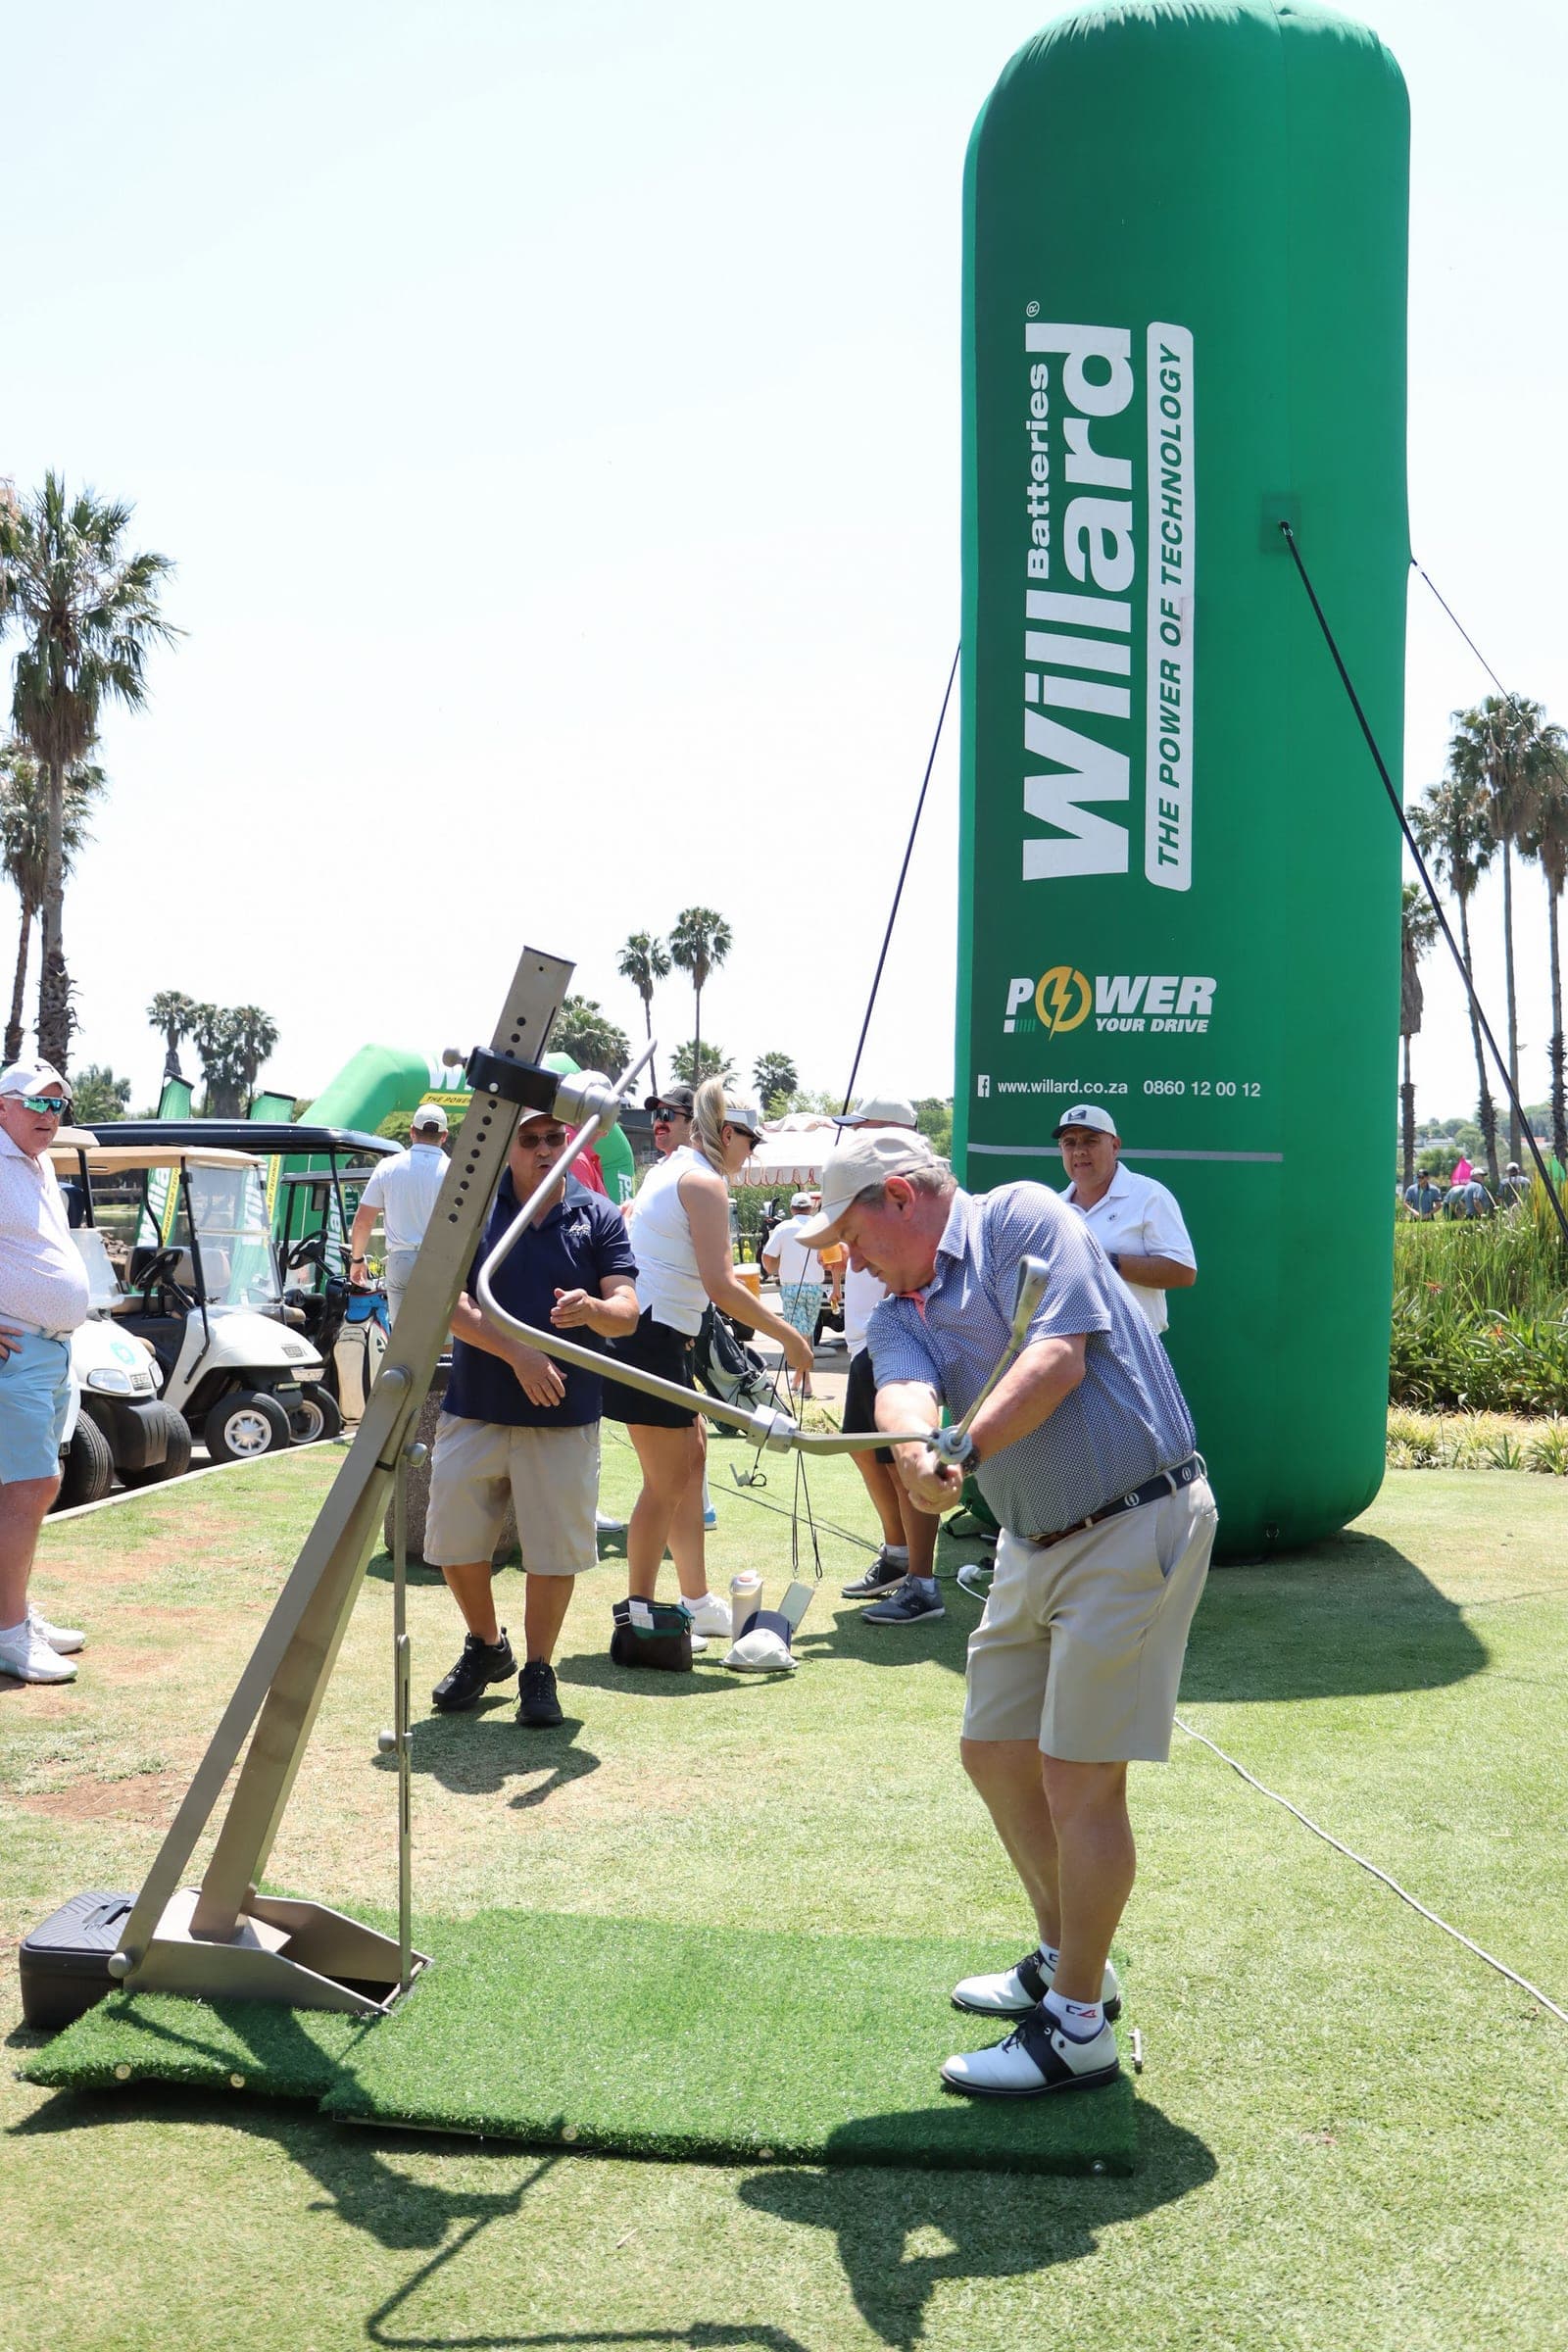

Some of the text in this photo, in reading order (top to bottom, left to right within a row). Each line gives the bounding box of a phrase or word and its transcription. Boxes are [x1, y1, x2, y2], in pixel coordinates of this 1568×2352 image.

[1026, 363, 1049, 580] Batteries
[1023, 322, 1135, 881] Willard
[1158, 344, 1183, 866] THE POWER OF TECHNOLOGY
[998, 1079, 1128, 1094] www.willard.co.za
[1143, 1080, 1185, 1096] 0860
[1191, 1081, 1210, 1096] 12
[1215, 1082, 1236, 1097] 00
[1242, 1082, 1261, 1097] 12
[1096, 1018, 1209, 1033] YOUR DRIVE
